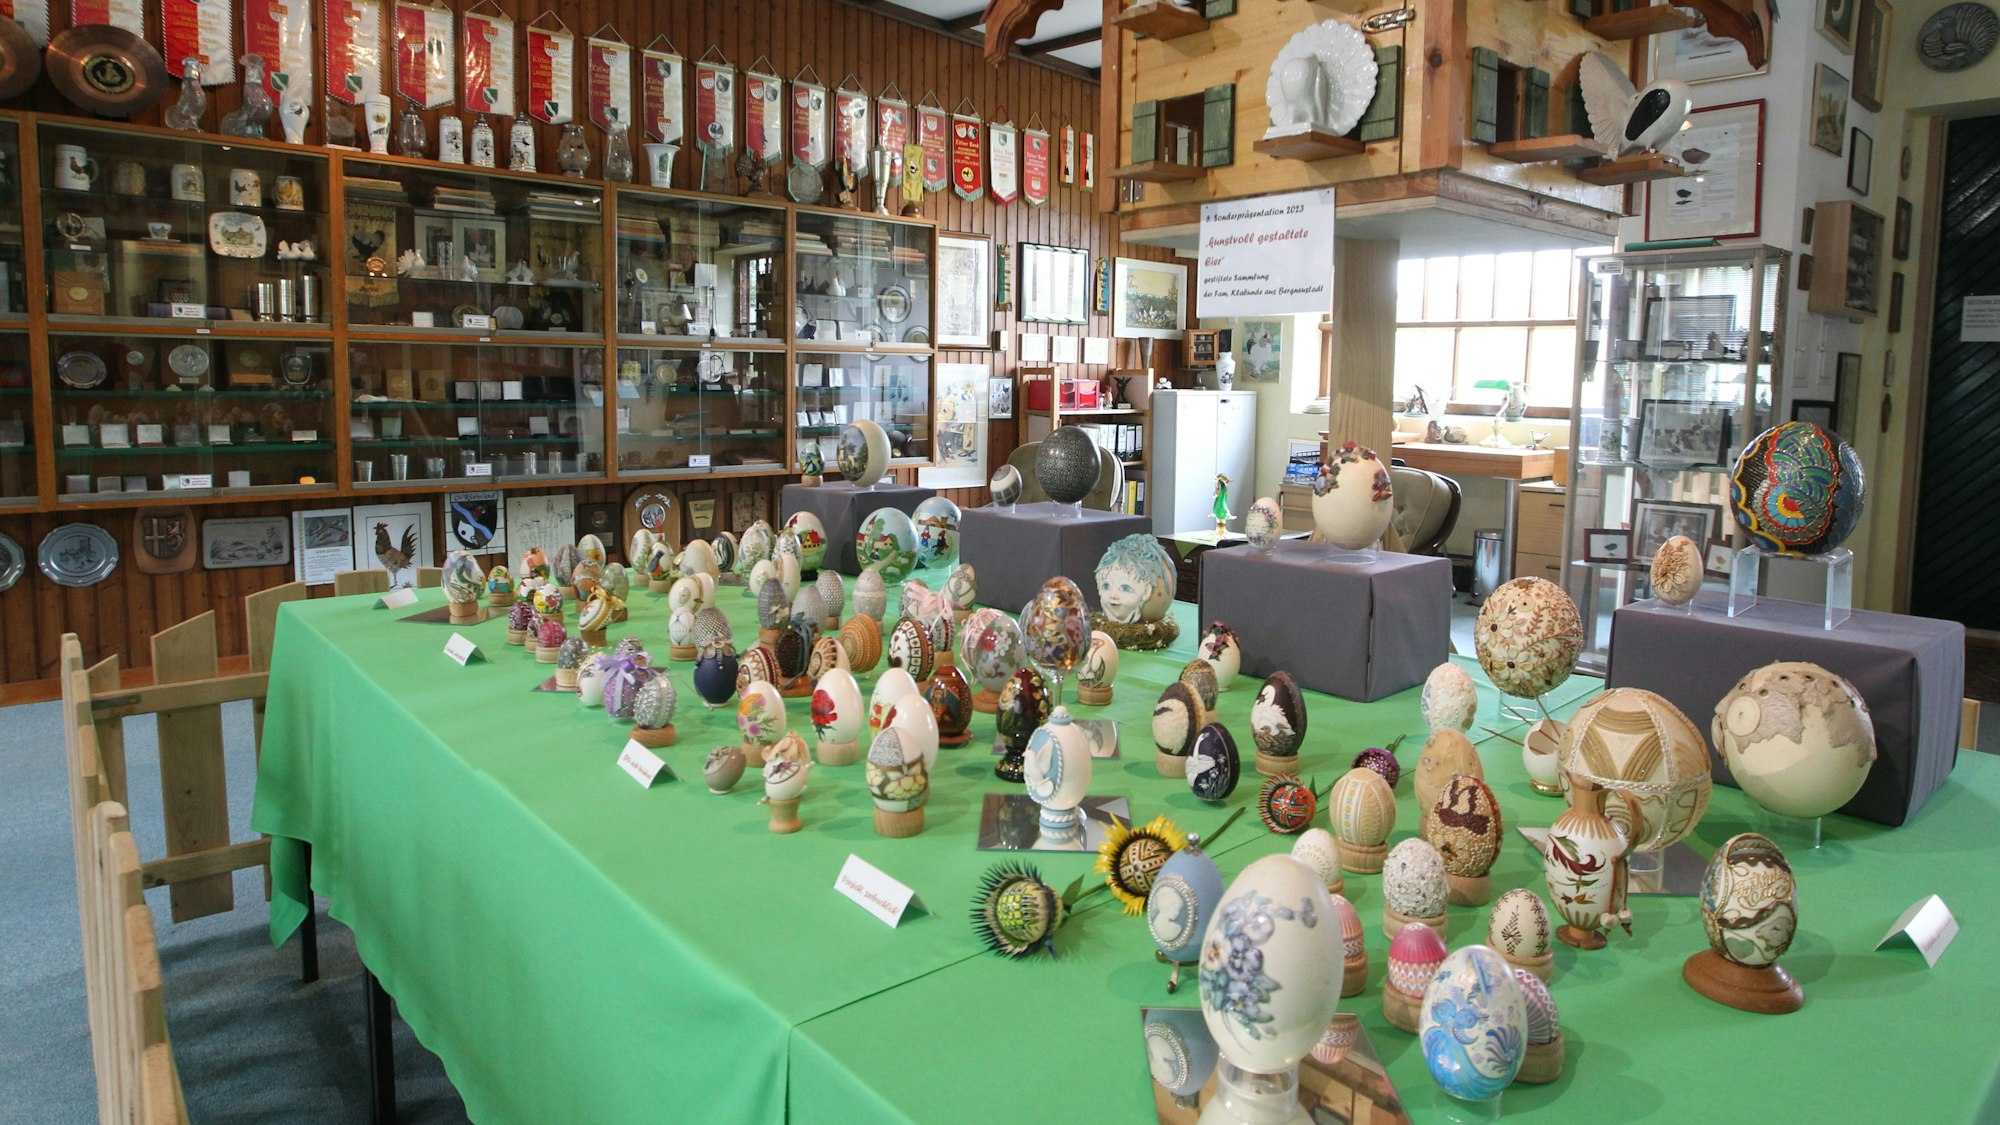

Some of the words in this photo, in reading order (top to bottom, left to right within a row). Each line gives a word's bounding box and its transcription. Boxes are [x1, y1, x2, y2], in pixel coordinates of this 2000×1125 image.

[1213, 208, 1284, 222] Sonderpräsentation
[1286, 204, 1305, 214] 2023
[1257, 229, 1309, 245] gestaltete
[1233, 273, 1269, 282] Sammlung
[1230, 288, 1263, 297] Klabunde
[1278, 284, 1324, 296] Bergneustadt
